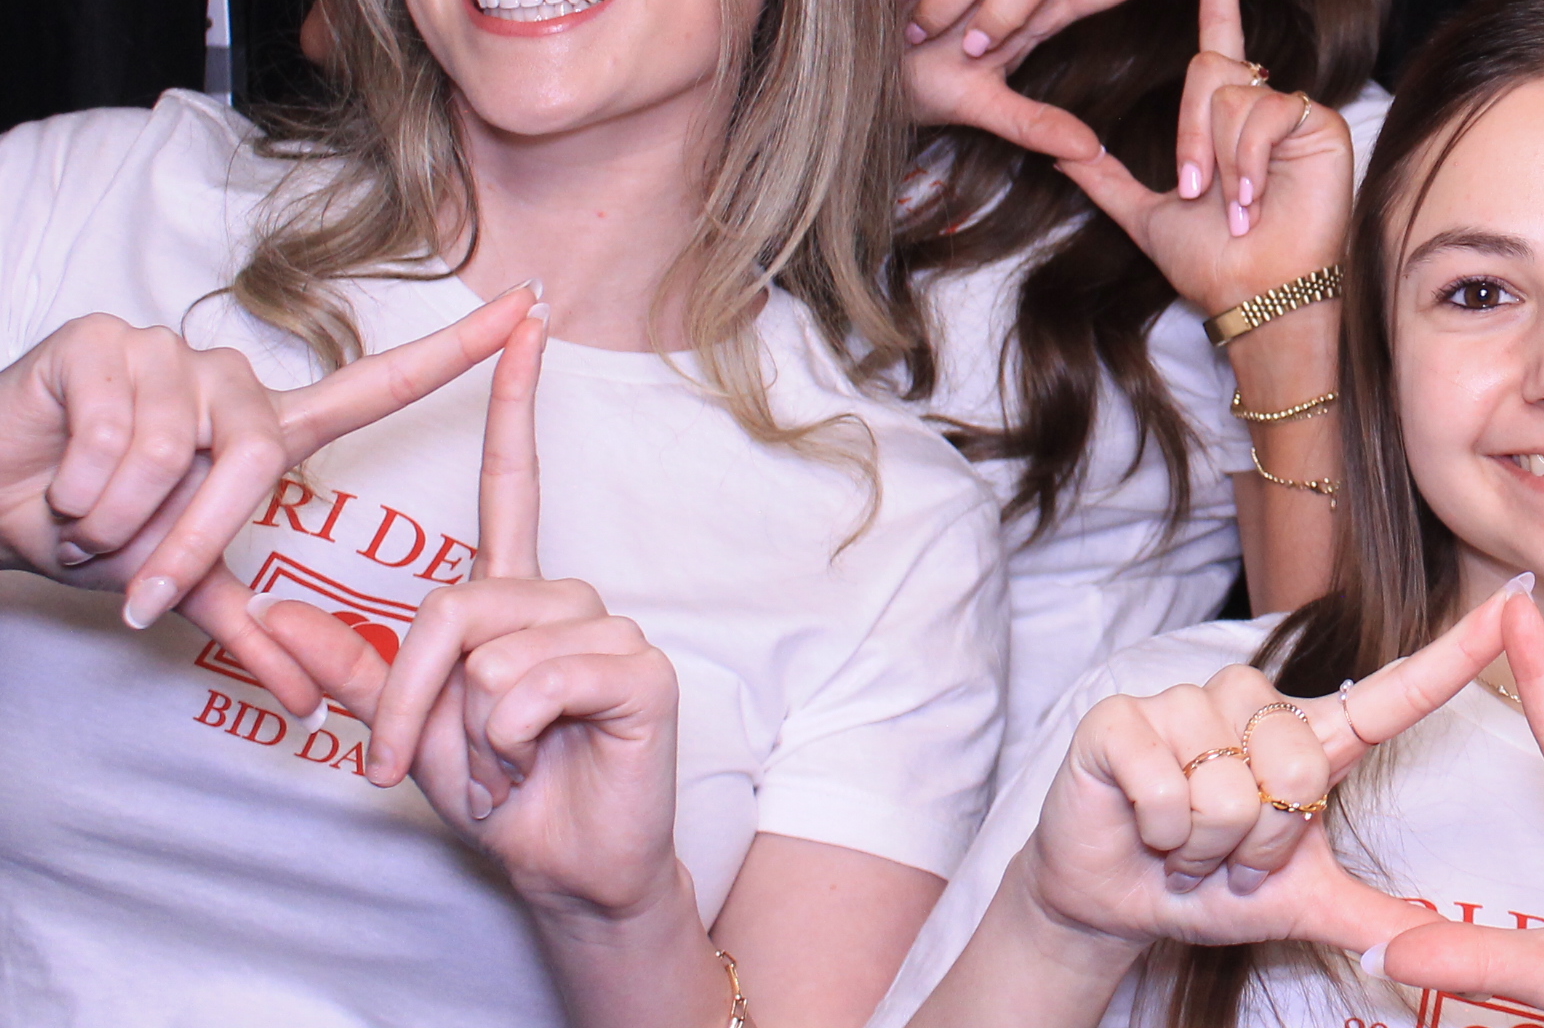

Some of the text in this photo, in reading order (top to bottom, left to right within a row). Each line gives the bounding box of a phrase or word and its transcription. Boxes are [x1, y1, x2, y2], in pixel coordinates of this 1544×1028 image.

[252, 477, 478, 586] RI DE
[192, 688, 366, 777] BID DA
